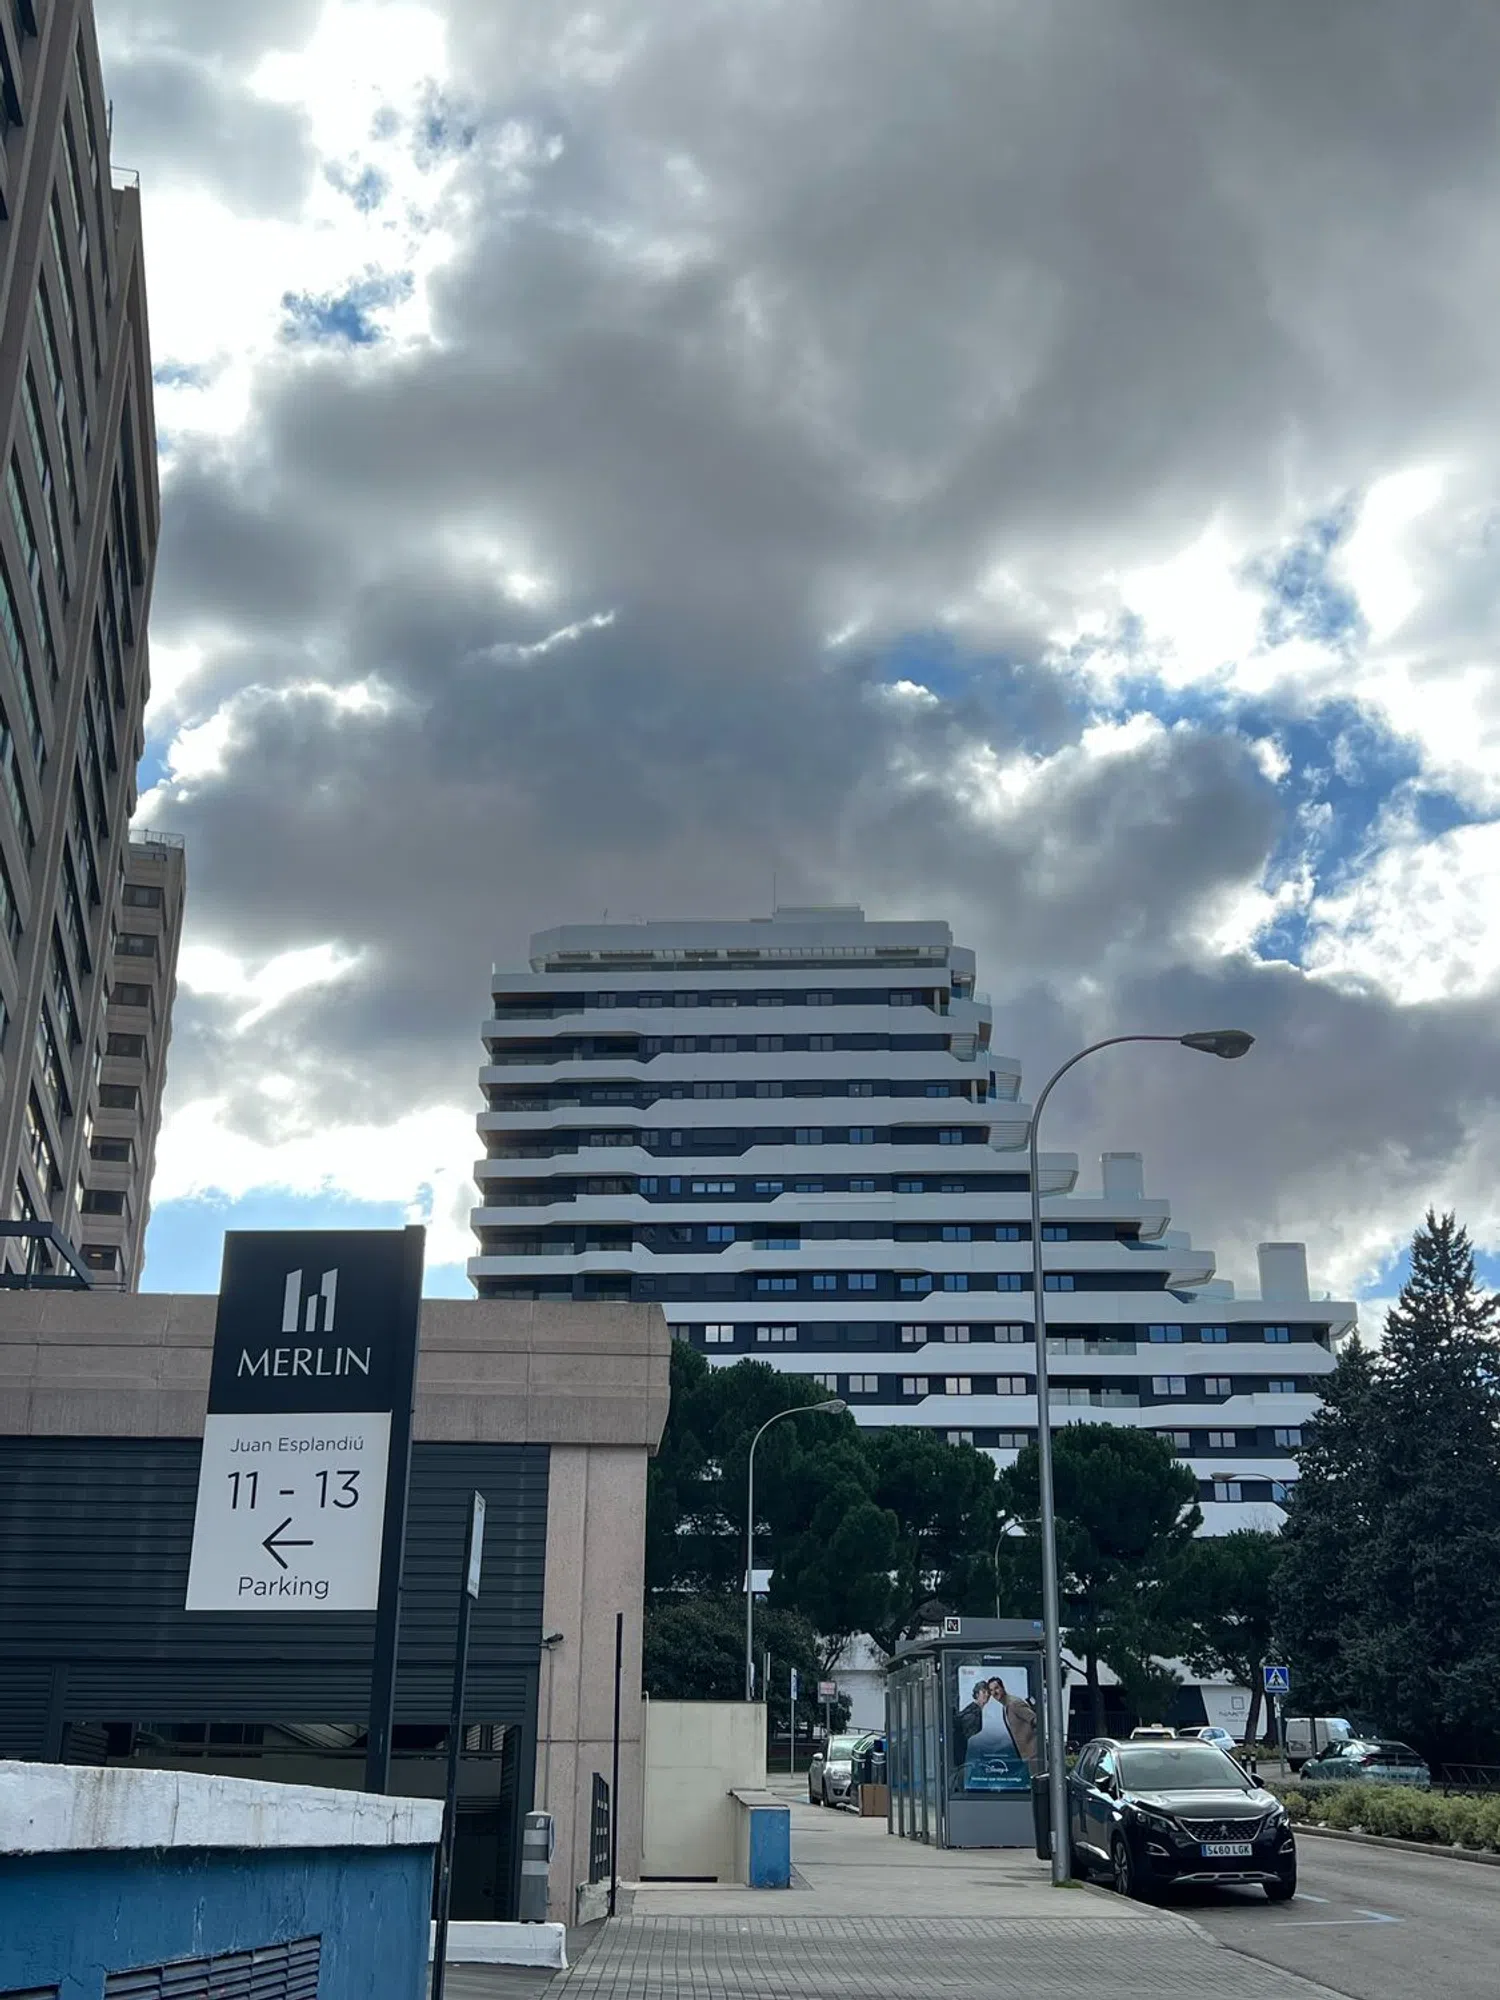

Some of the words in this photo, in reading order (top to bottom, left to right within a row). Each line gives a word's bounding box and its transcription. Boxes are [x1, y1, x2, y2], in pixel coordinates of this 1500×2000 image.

[237, 1346, 372, 1377] MERLIN
[230, 1437, 272, 1453] Juan
[278, 1435, 364, 1454] Esplandiú
[227, 1470, 259, 1510] 11
[315, 1469, 361, 1509] 13
[238, 1575, 329, 1600] Parking
